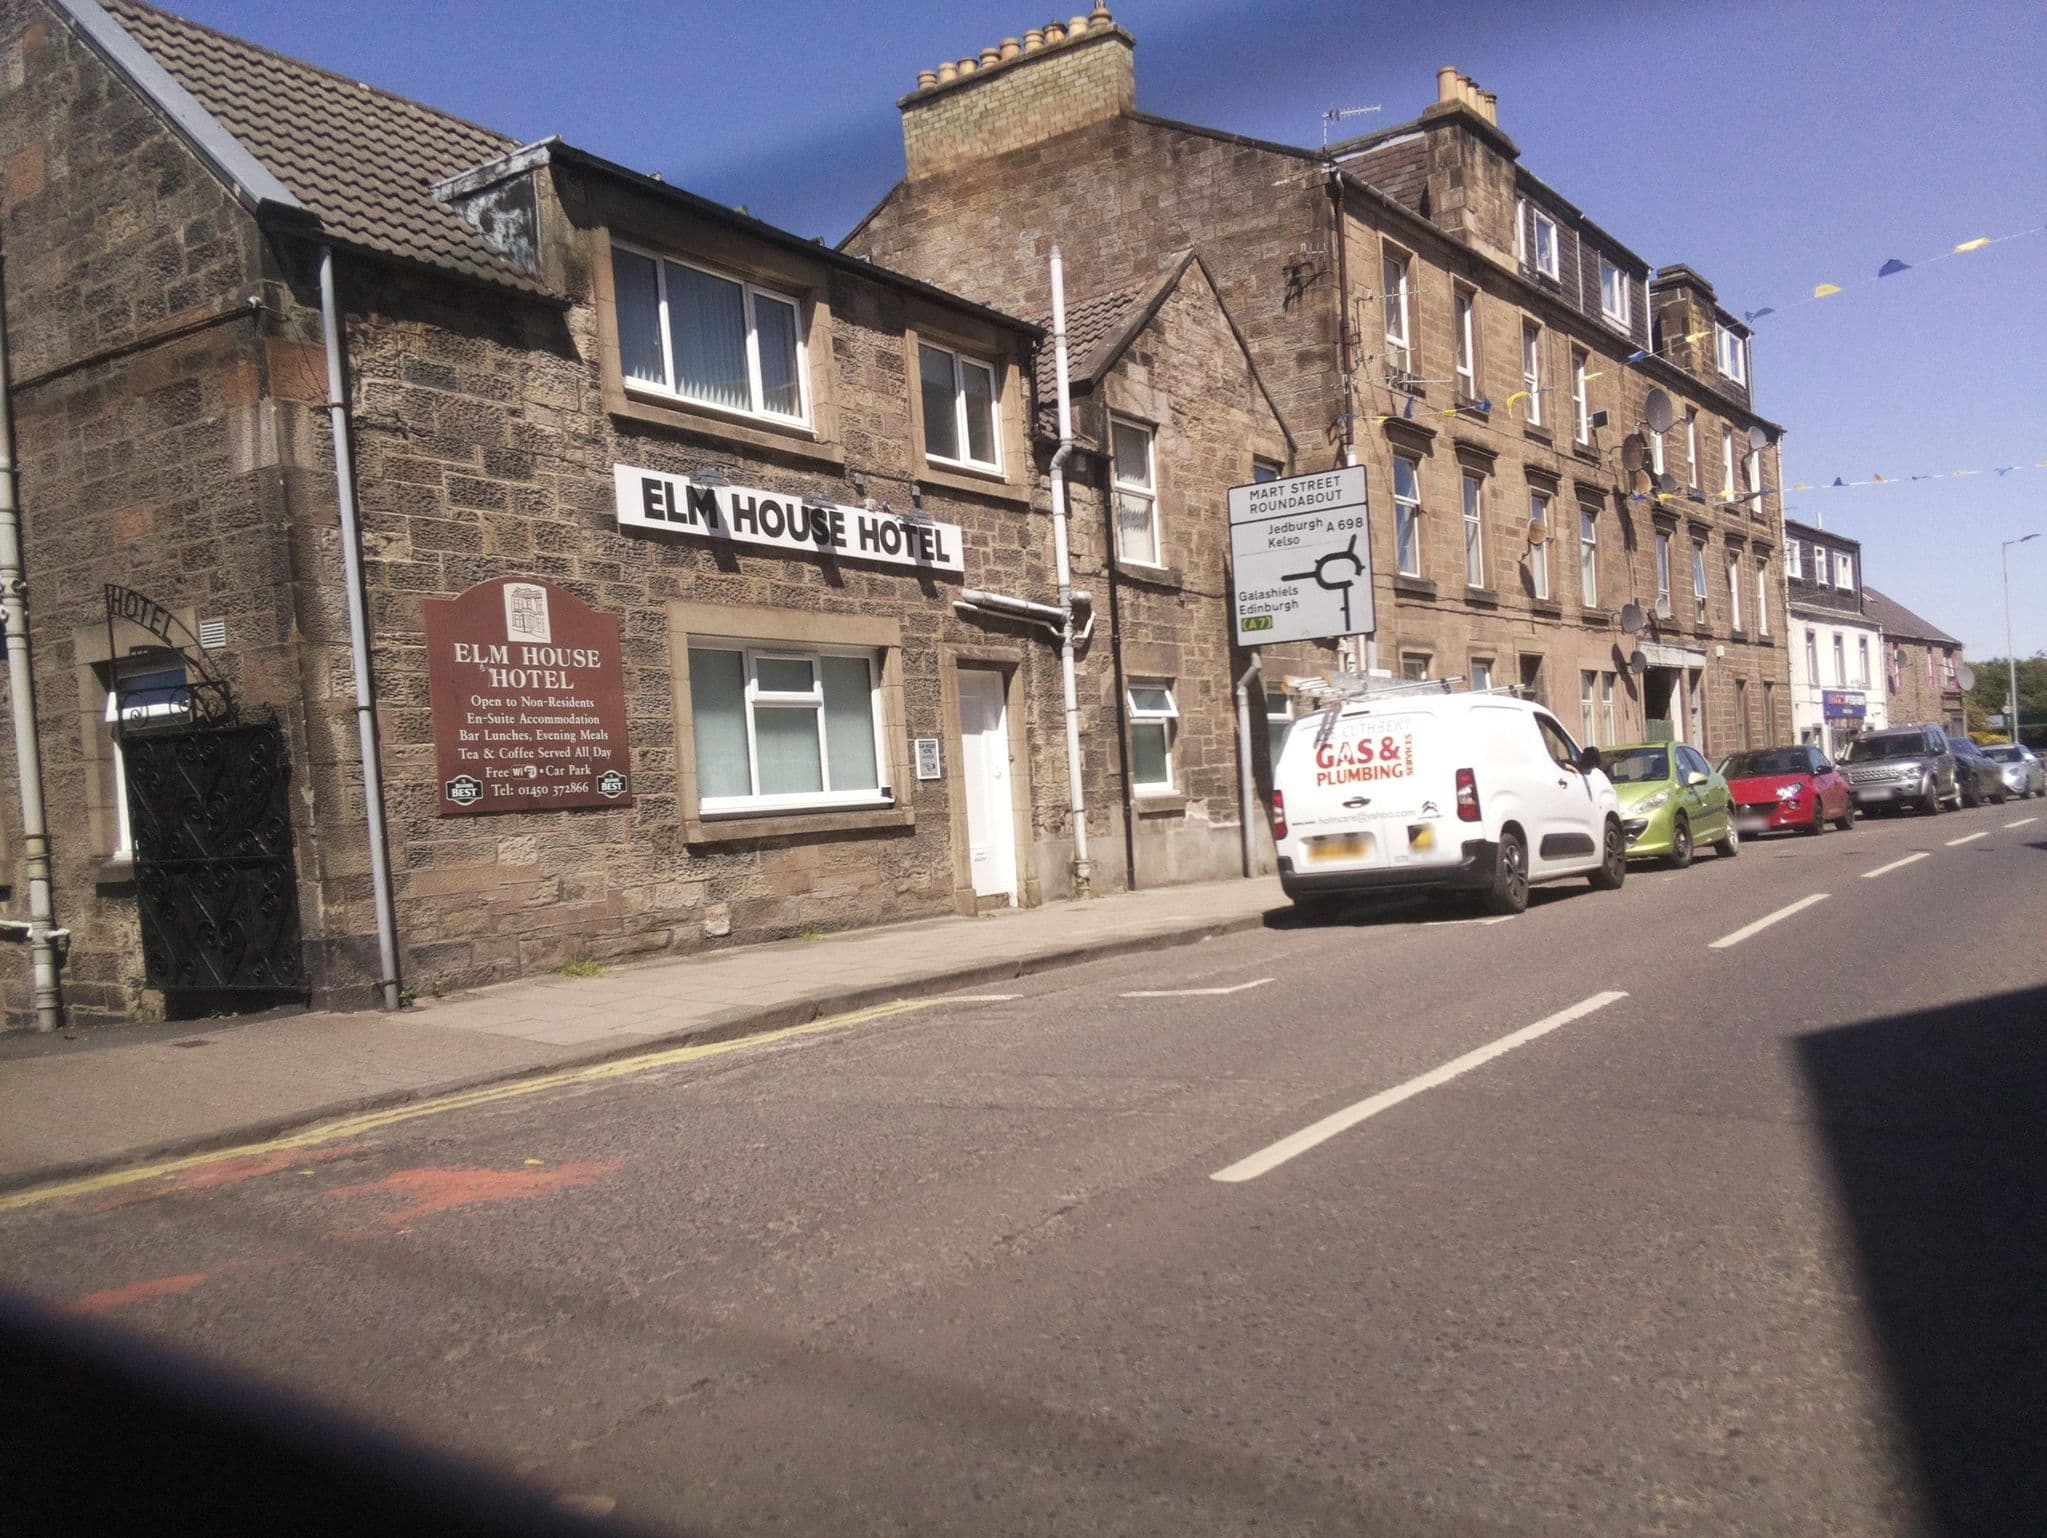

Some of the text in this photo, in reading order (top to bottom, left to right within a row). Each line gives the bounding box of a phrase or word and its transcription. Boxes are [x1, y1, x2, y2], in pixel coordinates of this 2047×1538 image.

[1250, 476, 1340, 501] MART STREET
[1250, 489, 1342, 514] ROUNDABOUT
[641, 477, 950, 563] ELM HOUSE HOTEL
[1268, 517, 1323, 535] Jedburgh
[1268, 536, 1300, 548] Kelso
[1239, 586, 1299, 602] Galashiels
[1239, 599, 1299, 615] Edinburgh
[111, 588, 173, 644] HOTEL
[453, 642, 601, 668] ELM HOUSE
[490, 668, 575, 690] HOTEL
[471, 694, 595, 710] Open to Non-Residents
[466, 712, 600, 725] En-Suite Accommodation
[459, 729, 609, 743] Bar Lunches, Evening Meals
[458, 746, 612, 760] Tea & Coffee Served All Day
[1316, 736, 1402, 769] GAS &
[485, 766, 510, 778] Free
[545, 764, 565, 776] Car
[569, 764, 592, 776] Park
[1316, 763, 1403, 787] PLUMBING
[451, 788, 478, 798] BEST
[491, 782, 589, 797] Tel: 01450 372866
[601, 782, 622, 791] BEST
